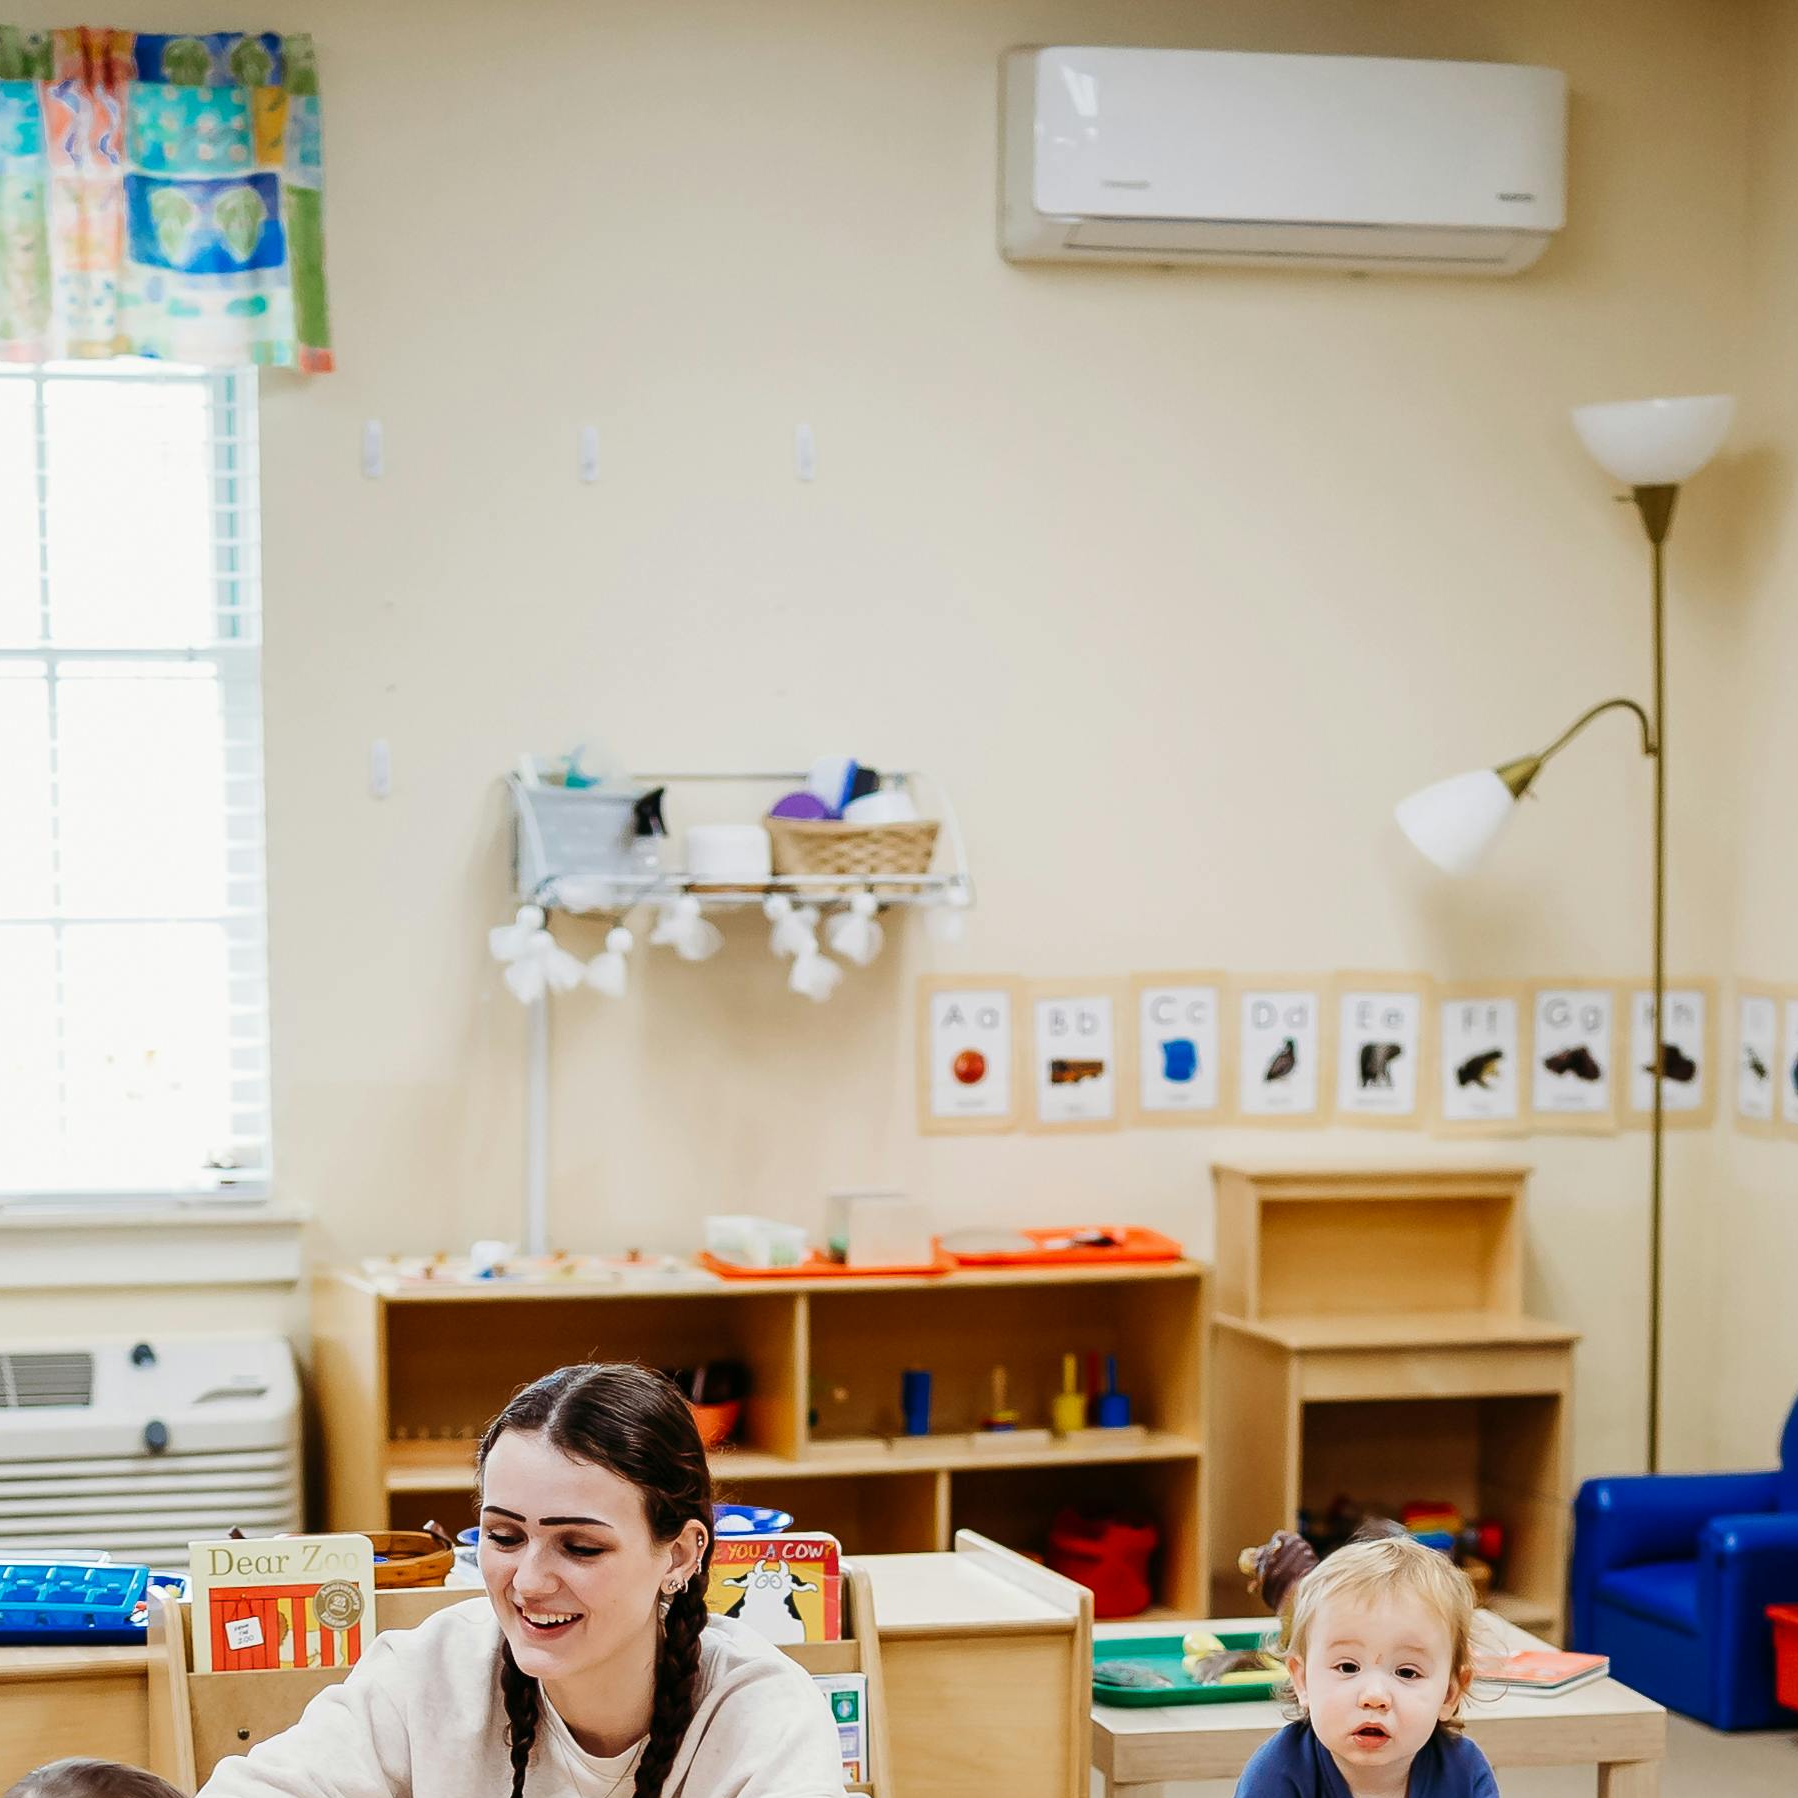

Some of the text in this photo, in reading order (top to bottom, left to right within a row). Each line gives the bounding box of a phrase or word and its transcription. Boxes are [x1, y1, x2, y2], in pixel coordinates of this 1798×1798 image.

[208, 1544, 359, 1576] Dear Zoo
[728, 1543, 761, 1560] YOU
[782, 1541, 835, 1559] COW?
